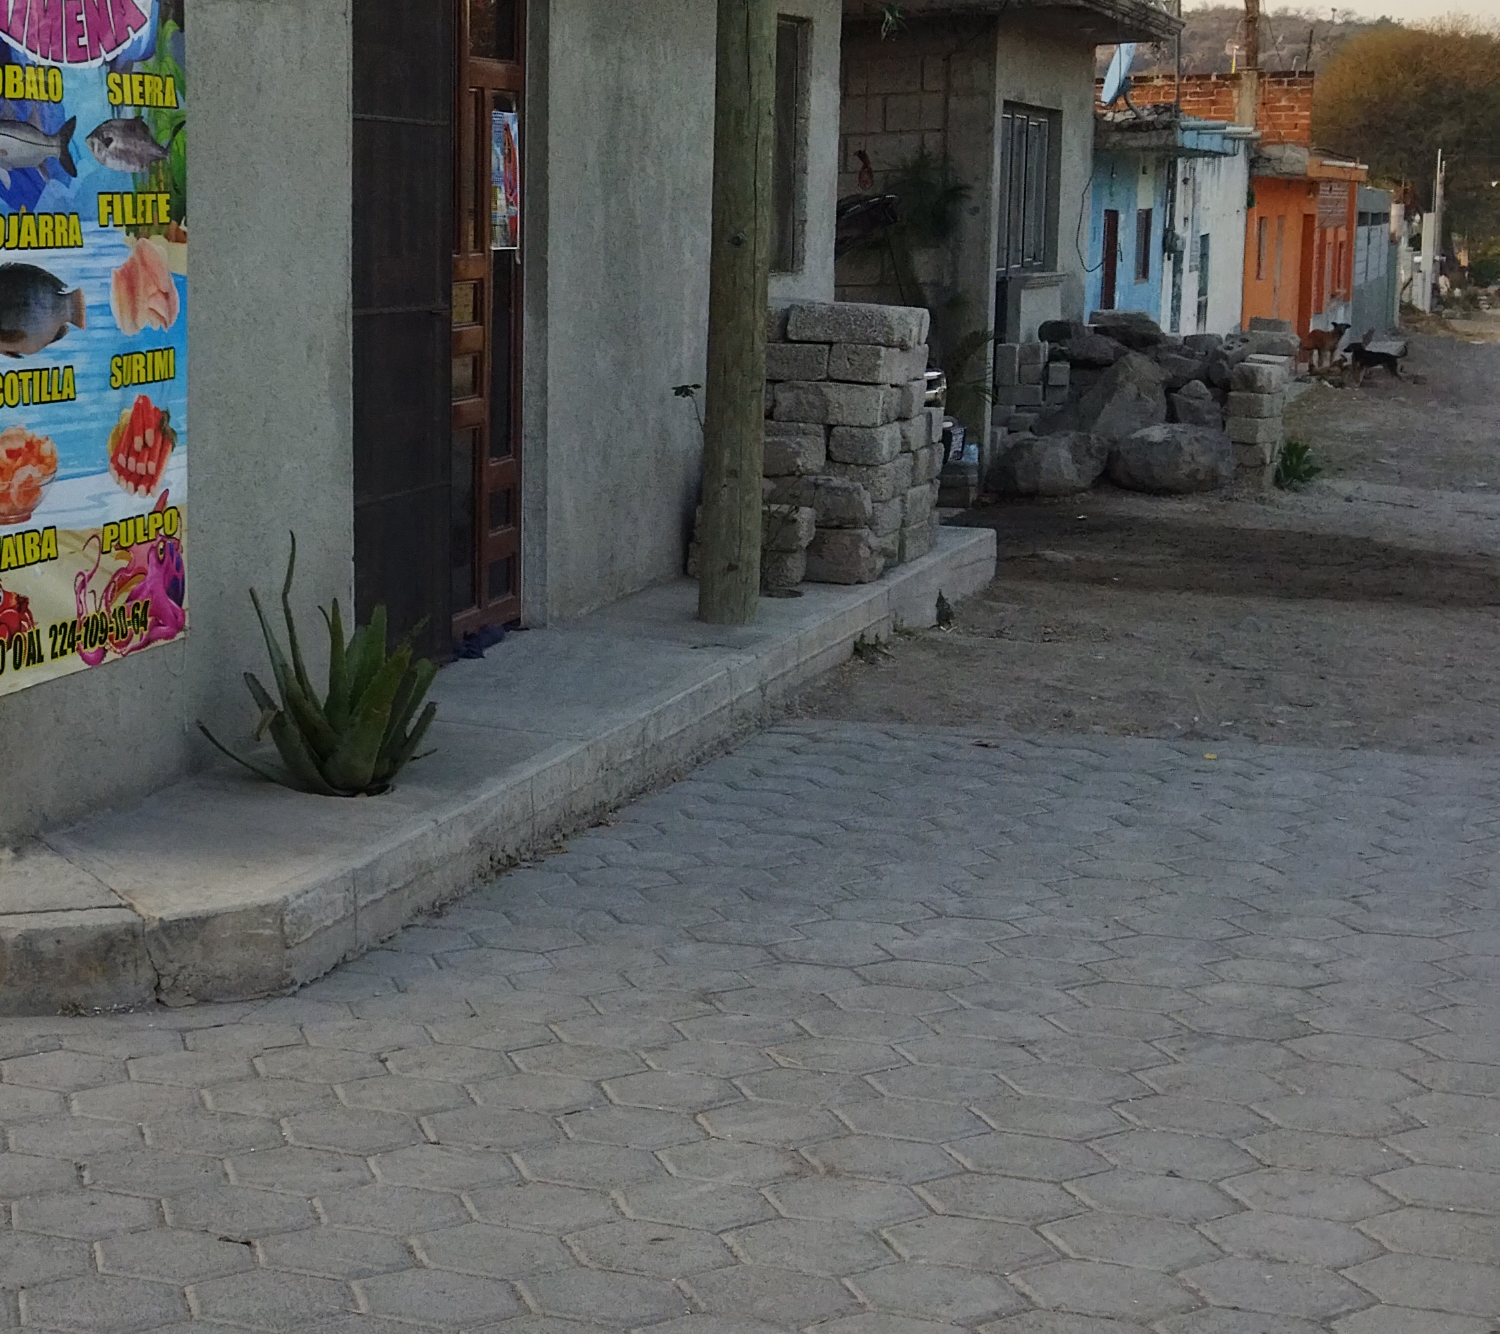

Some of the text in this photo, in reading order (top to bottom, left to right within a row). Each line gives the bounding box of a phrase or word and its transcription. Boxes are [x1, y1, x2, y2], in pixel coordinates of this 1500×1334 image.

[107, 72, 179, 109] SIERRA
[97, 191, 171, 227] FILETE
[109, 347, 176, 390] SURIMI
[101, 505, 179, 555] PULPO
[48, 597, 151, 661] 224-109-10-64
